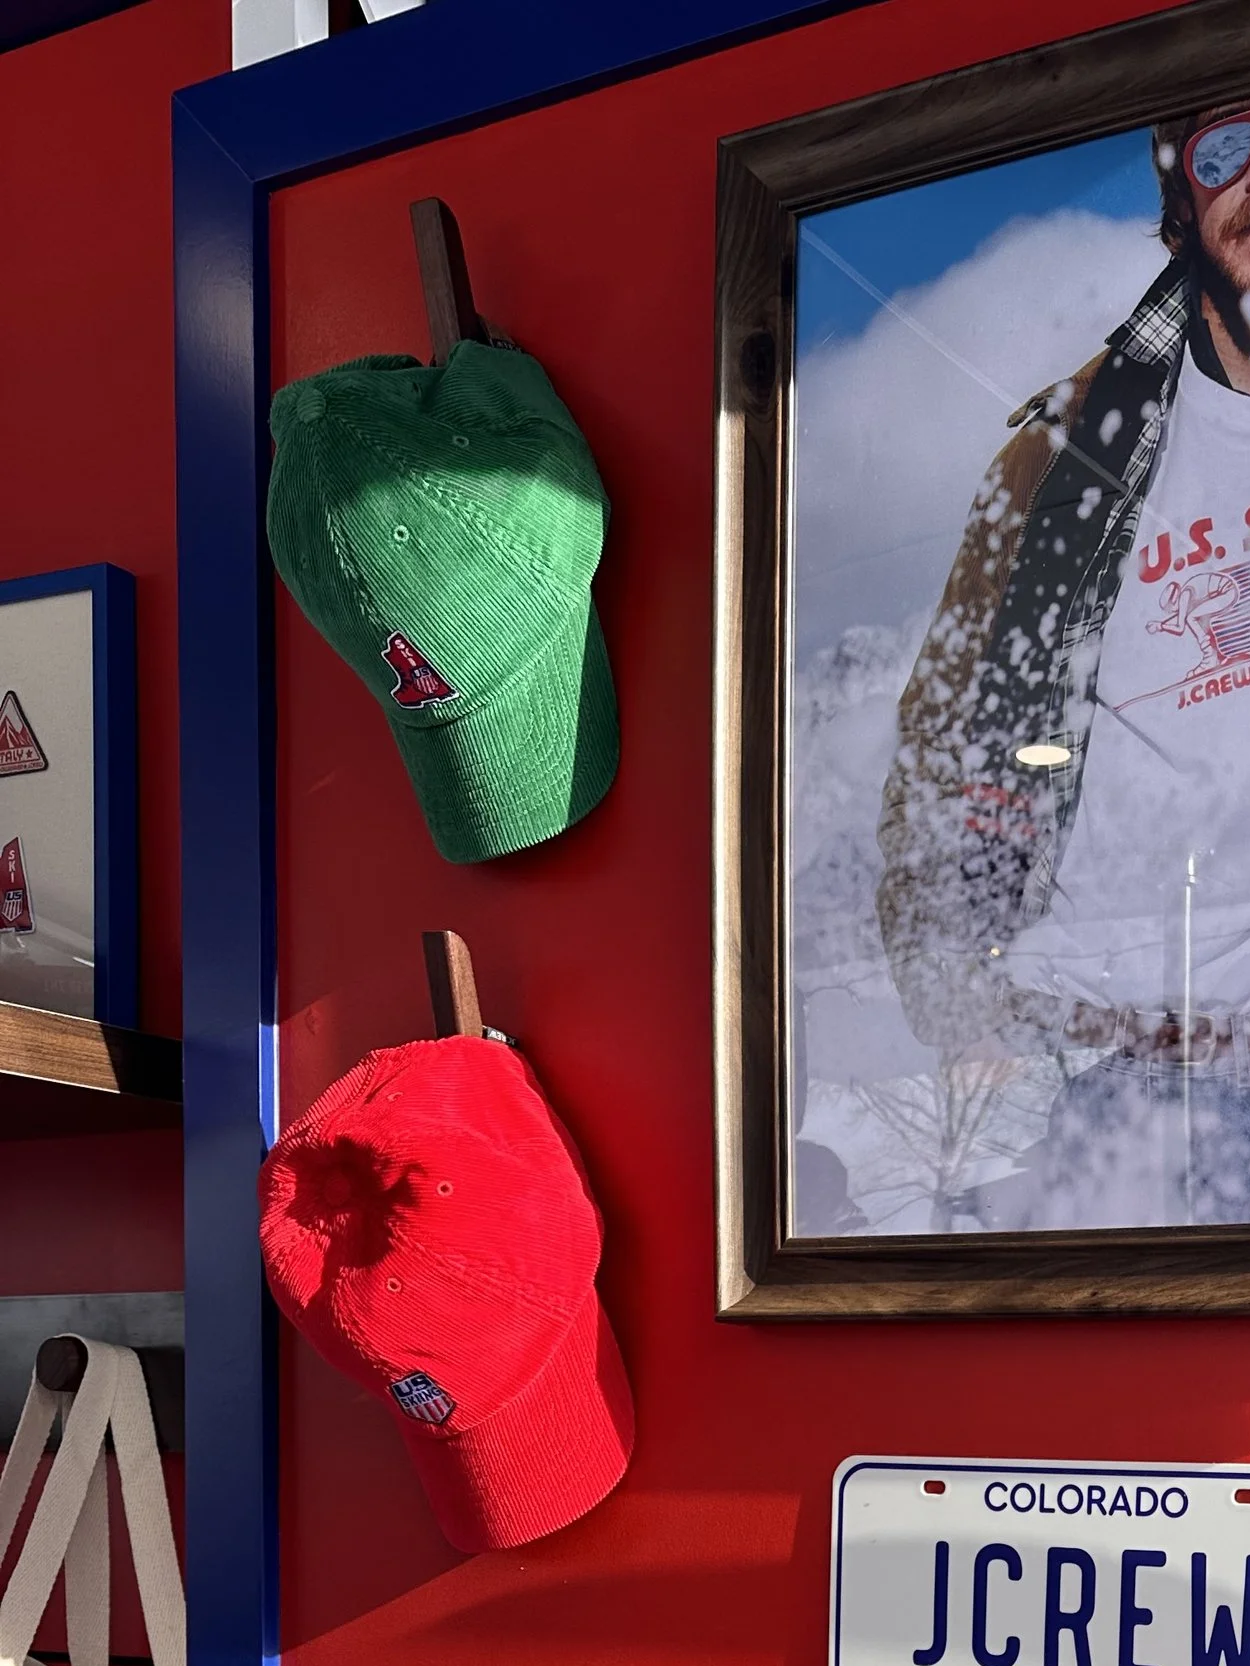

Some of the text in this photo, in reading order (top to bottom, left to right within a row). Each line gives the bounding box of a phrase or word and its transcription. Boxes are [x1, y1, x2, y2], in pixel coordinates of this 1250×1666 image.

[1138, 518, 1226, 583] U.S.
[0, 749, 24, 763] TALY
[8, 849, 16, 883] SKI
[7, 890, 22, 900] US
[392, 1373, 432, 1397] US
[400, 1386, 441, 1408] SKIING
[984, 1482, 1188, 1518] COLORADO
